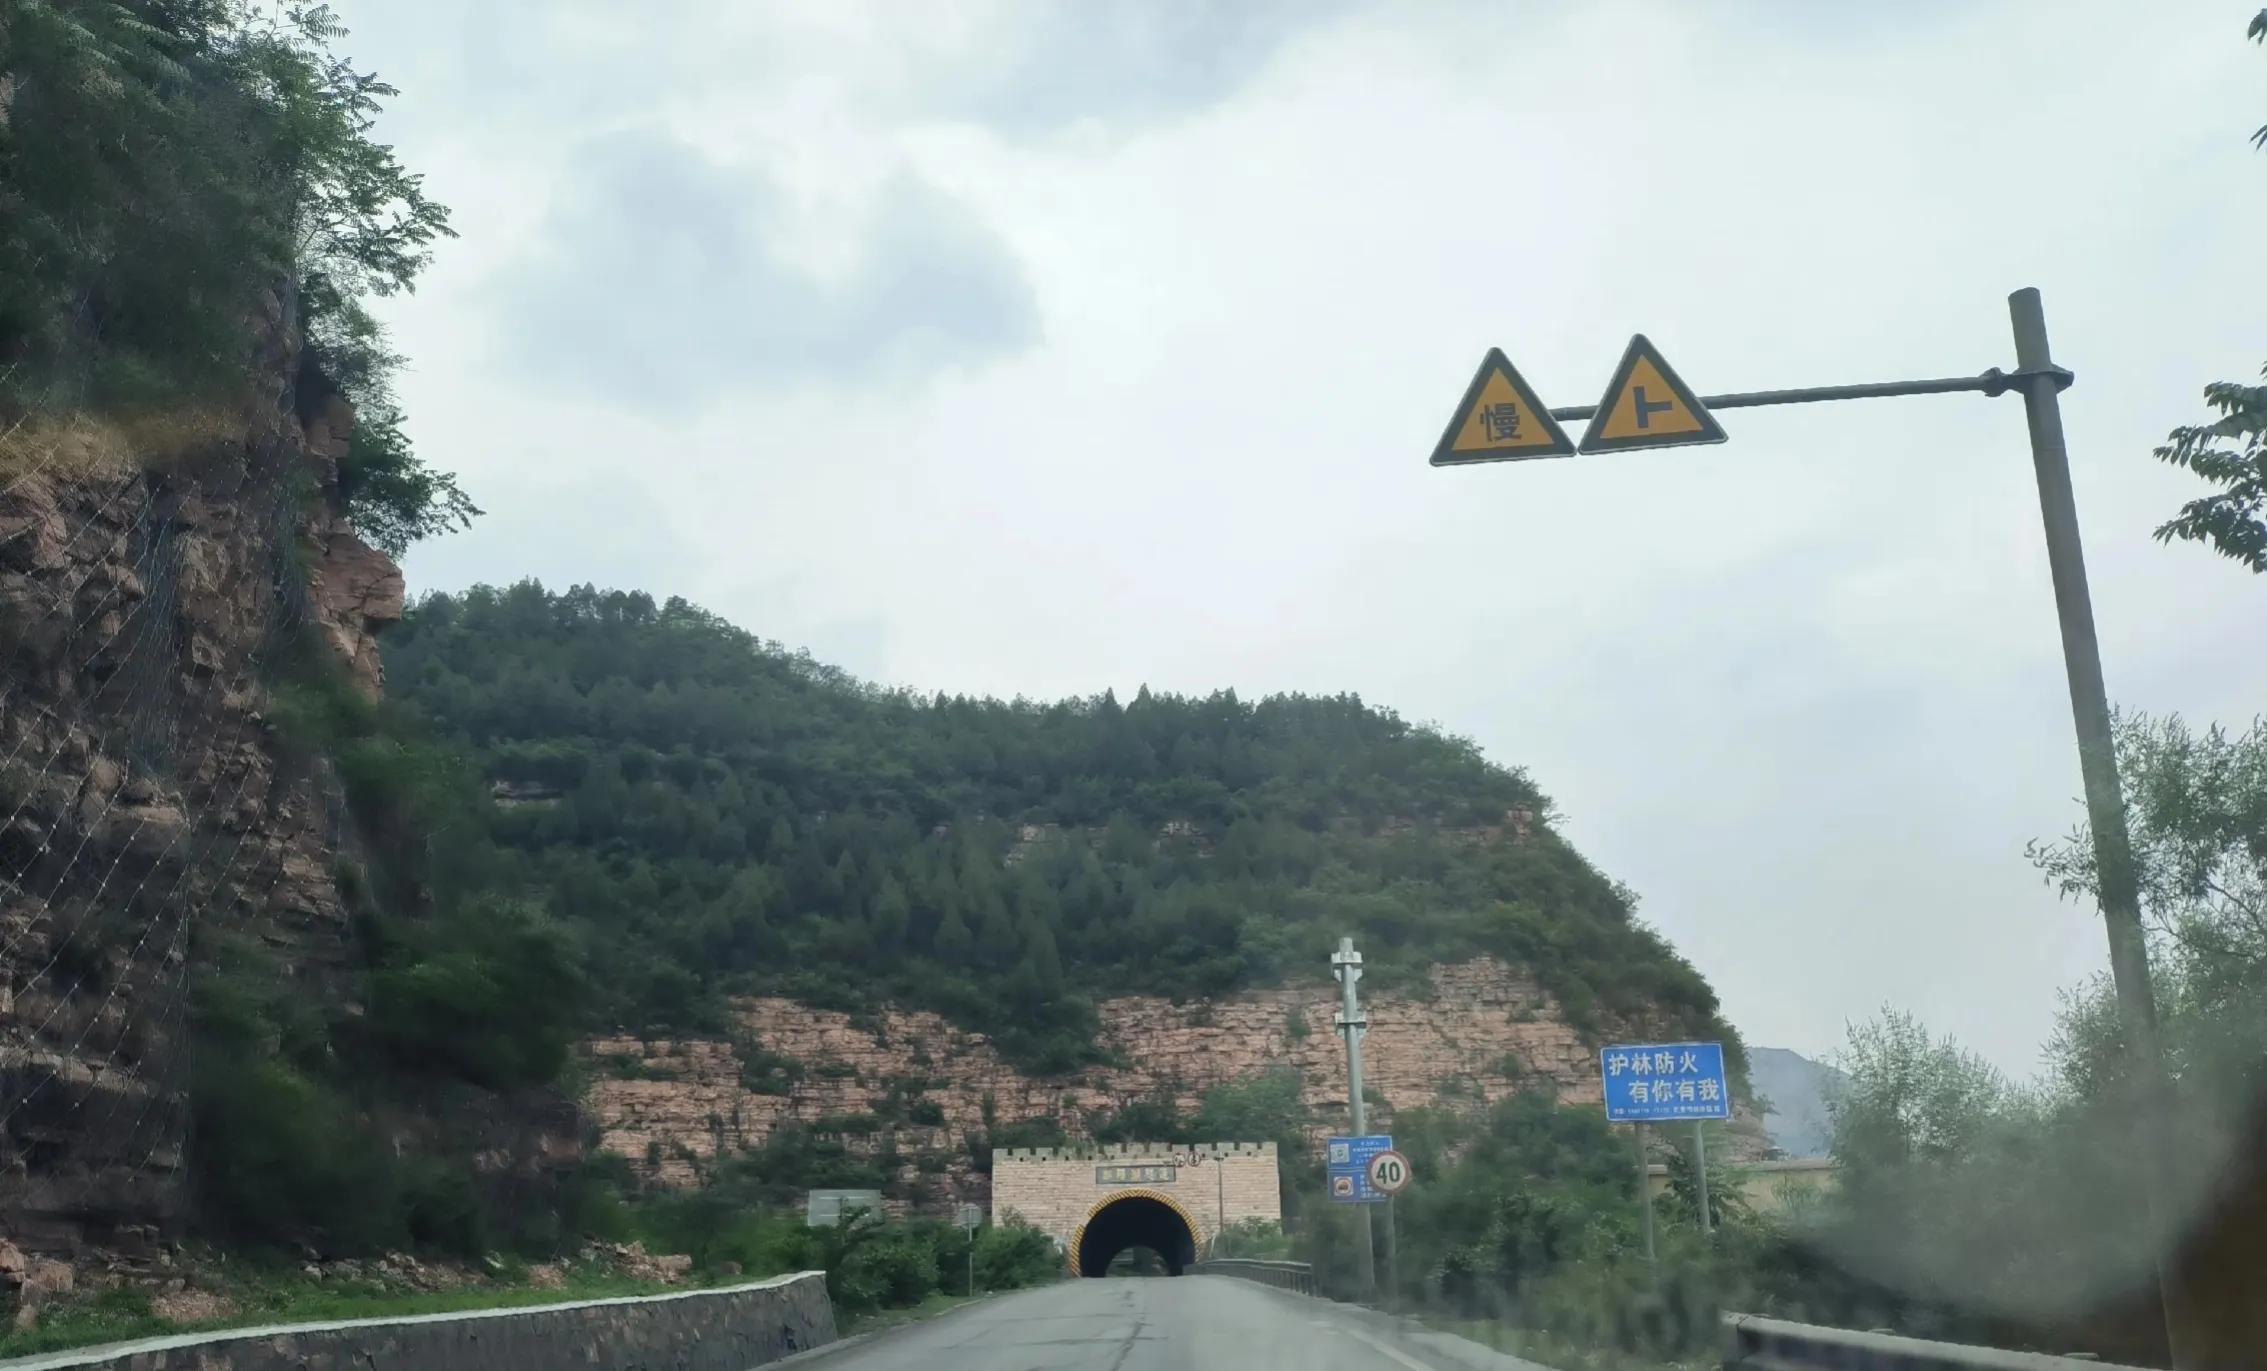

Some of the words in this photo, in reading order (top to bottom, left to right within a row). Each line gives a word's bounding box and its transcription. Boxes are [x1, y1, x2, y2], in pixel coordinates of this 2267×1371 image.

[1480, 403, 1522, 442] 慢
[1608, 1051, 1698, 1076] 护林防火
[1628, 1078, 1719, 1103] 有你有我
[1376, 1161, 1401, 1185] 40
